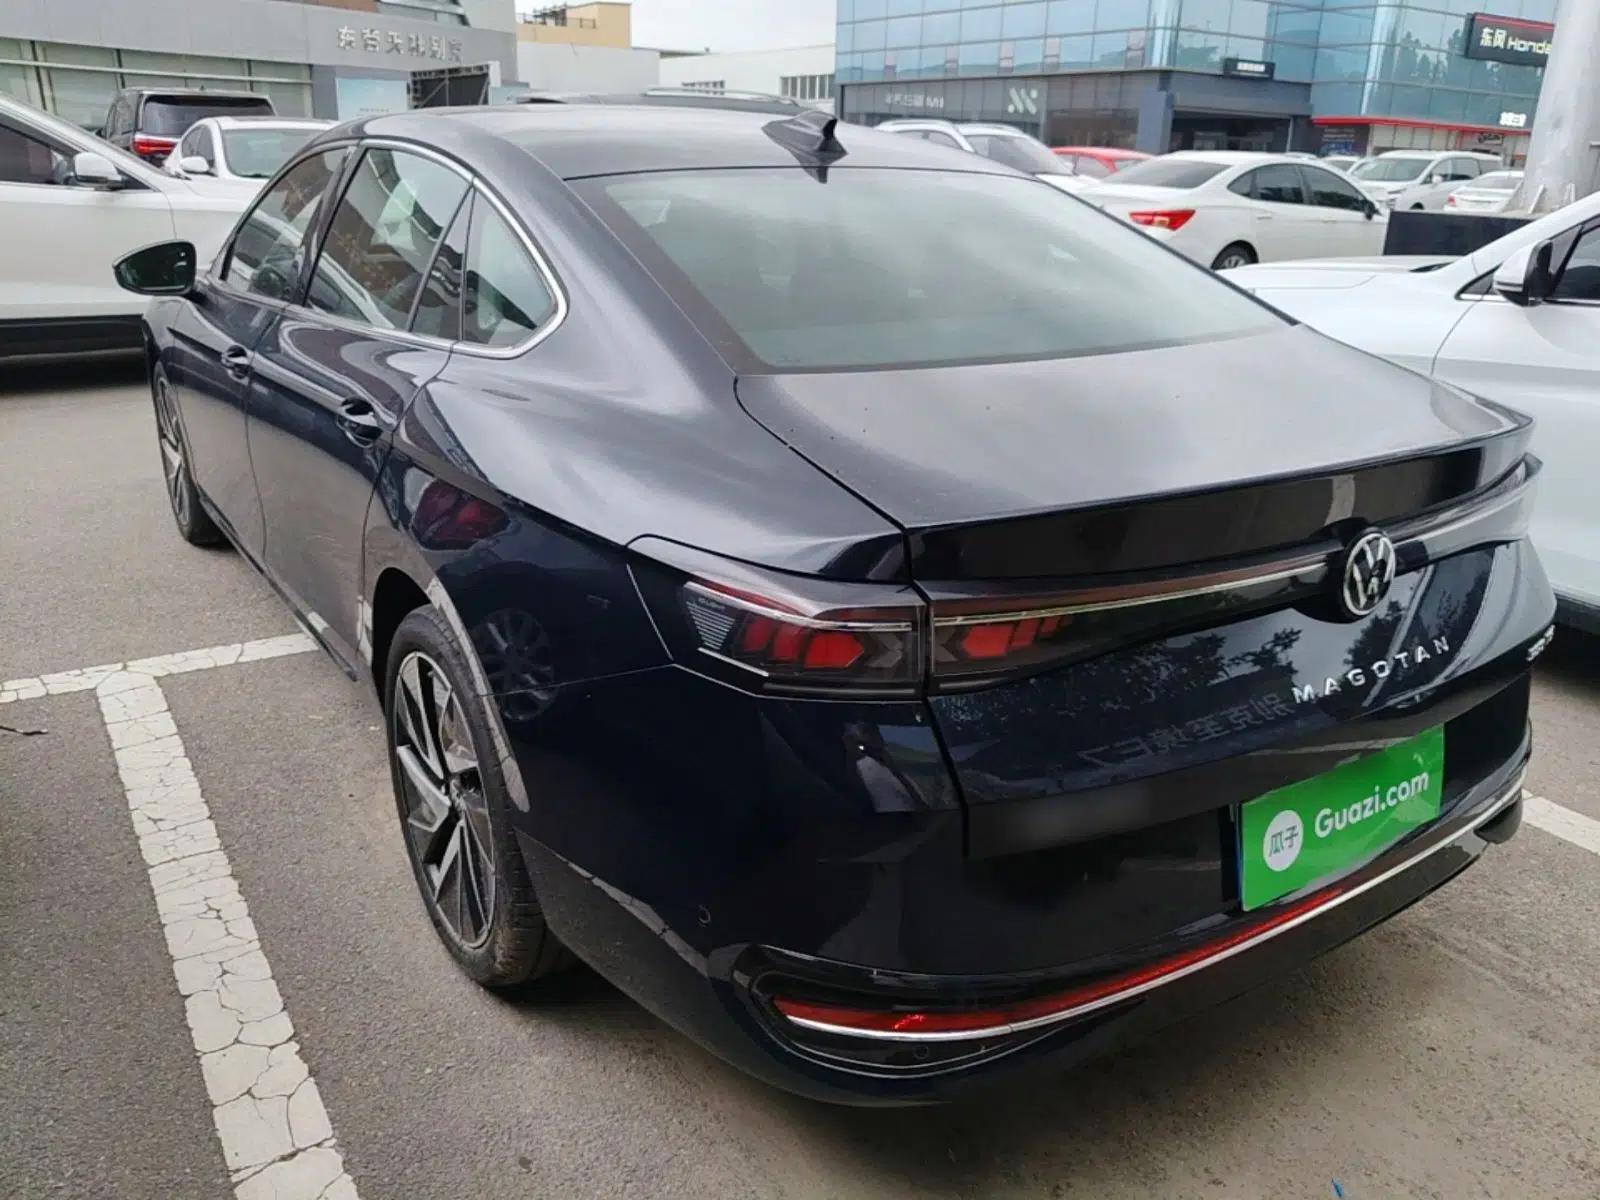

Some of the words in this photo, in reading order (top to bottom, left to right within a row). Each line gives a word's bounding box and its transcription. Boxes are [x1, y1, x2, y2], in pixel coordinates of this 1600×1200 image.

[1292, 636, 1450, 704] MAGOTAN
[1313, 770, 1430, 839] Guazi.com
[1267, 825, 1300, 858] 瓜子
